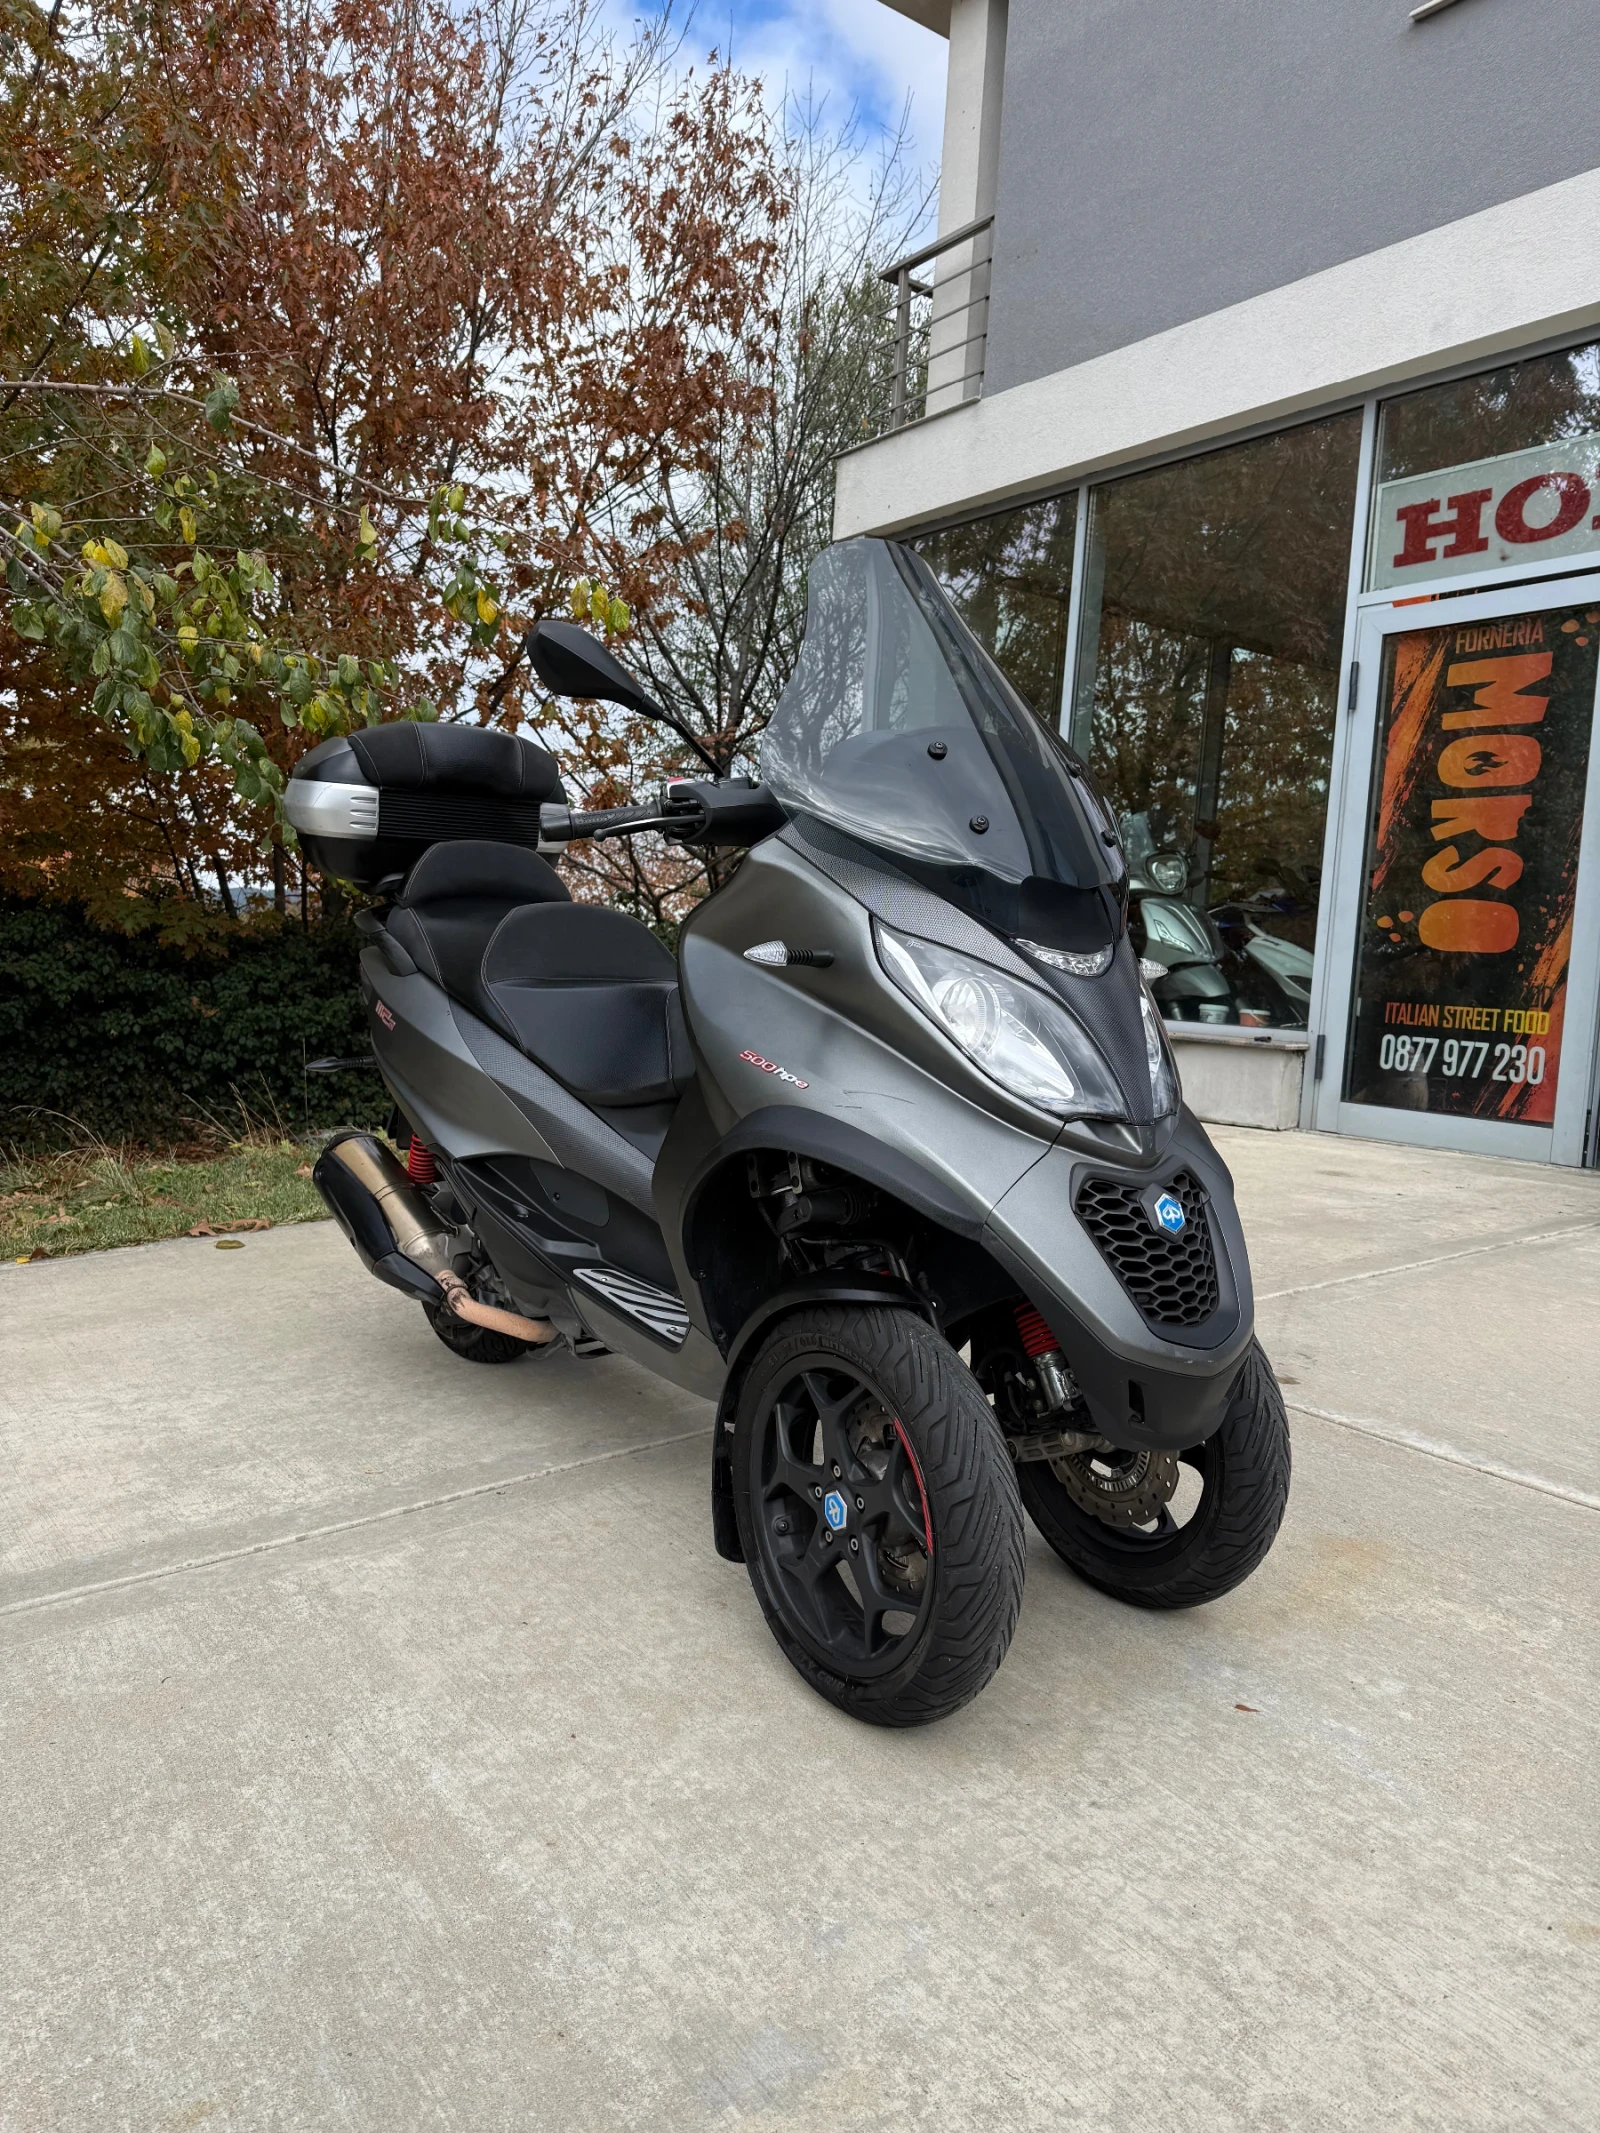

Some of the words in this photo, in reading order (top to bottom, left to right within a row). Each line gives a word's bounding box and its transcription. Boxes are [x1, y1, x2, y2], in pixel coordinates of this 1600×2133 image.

[1393, 463, 1600, 568] HO
[1455, 618, 1545, 654] FORNERIA
[1418, 651, 1553, 953] MORSO
[1384, 1002, 1440, 1028] ITALIAN
[1442, 1005, 1501, 1032] STREET
[1503, 1009, 1551, 1035] FOOD
[1379, 1033, 1440, 1074] 0877
[1441, 1039, 1490, 1079] 977
[1491, 1043, 1546, 1085] 230
